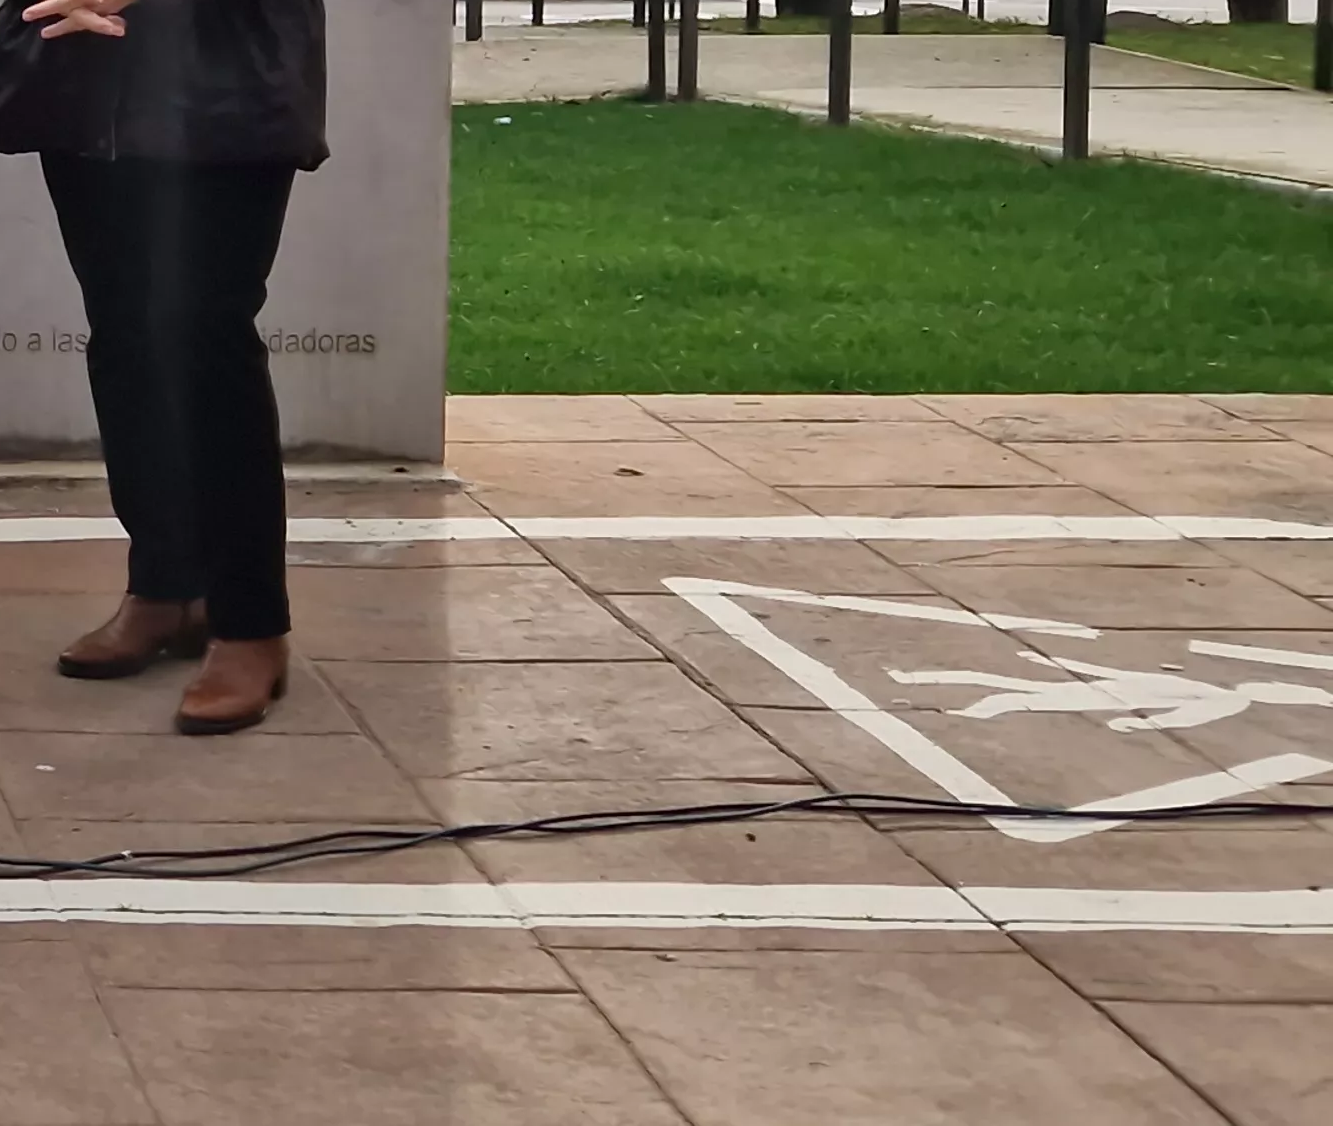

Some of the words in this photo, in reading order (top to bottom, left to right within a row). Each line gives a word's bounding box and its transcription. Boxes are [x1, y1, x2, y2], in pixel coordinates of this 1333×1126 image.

[27, 331, 42, 352] a
[52, 326, 89, 353] las
[260, 326, 376, 354] idadoras
